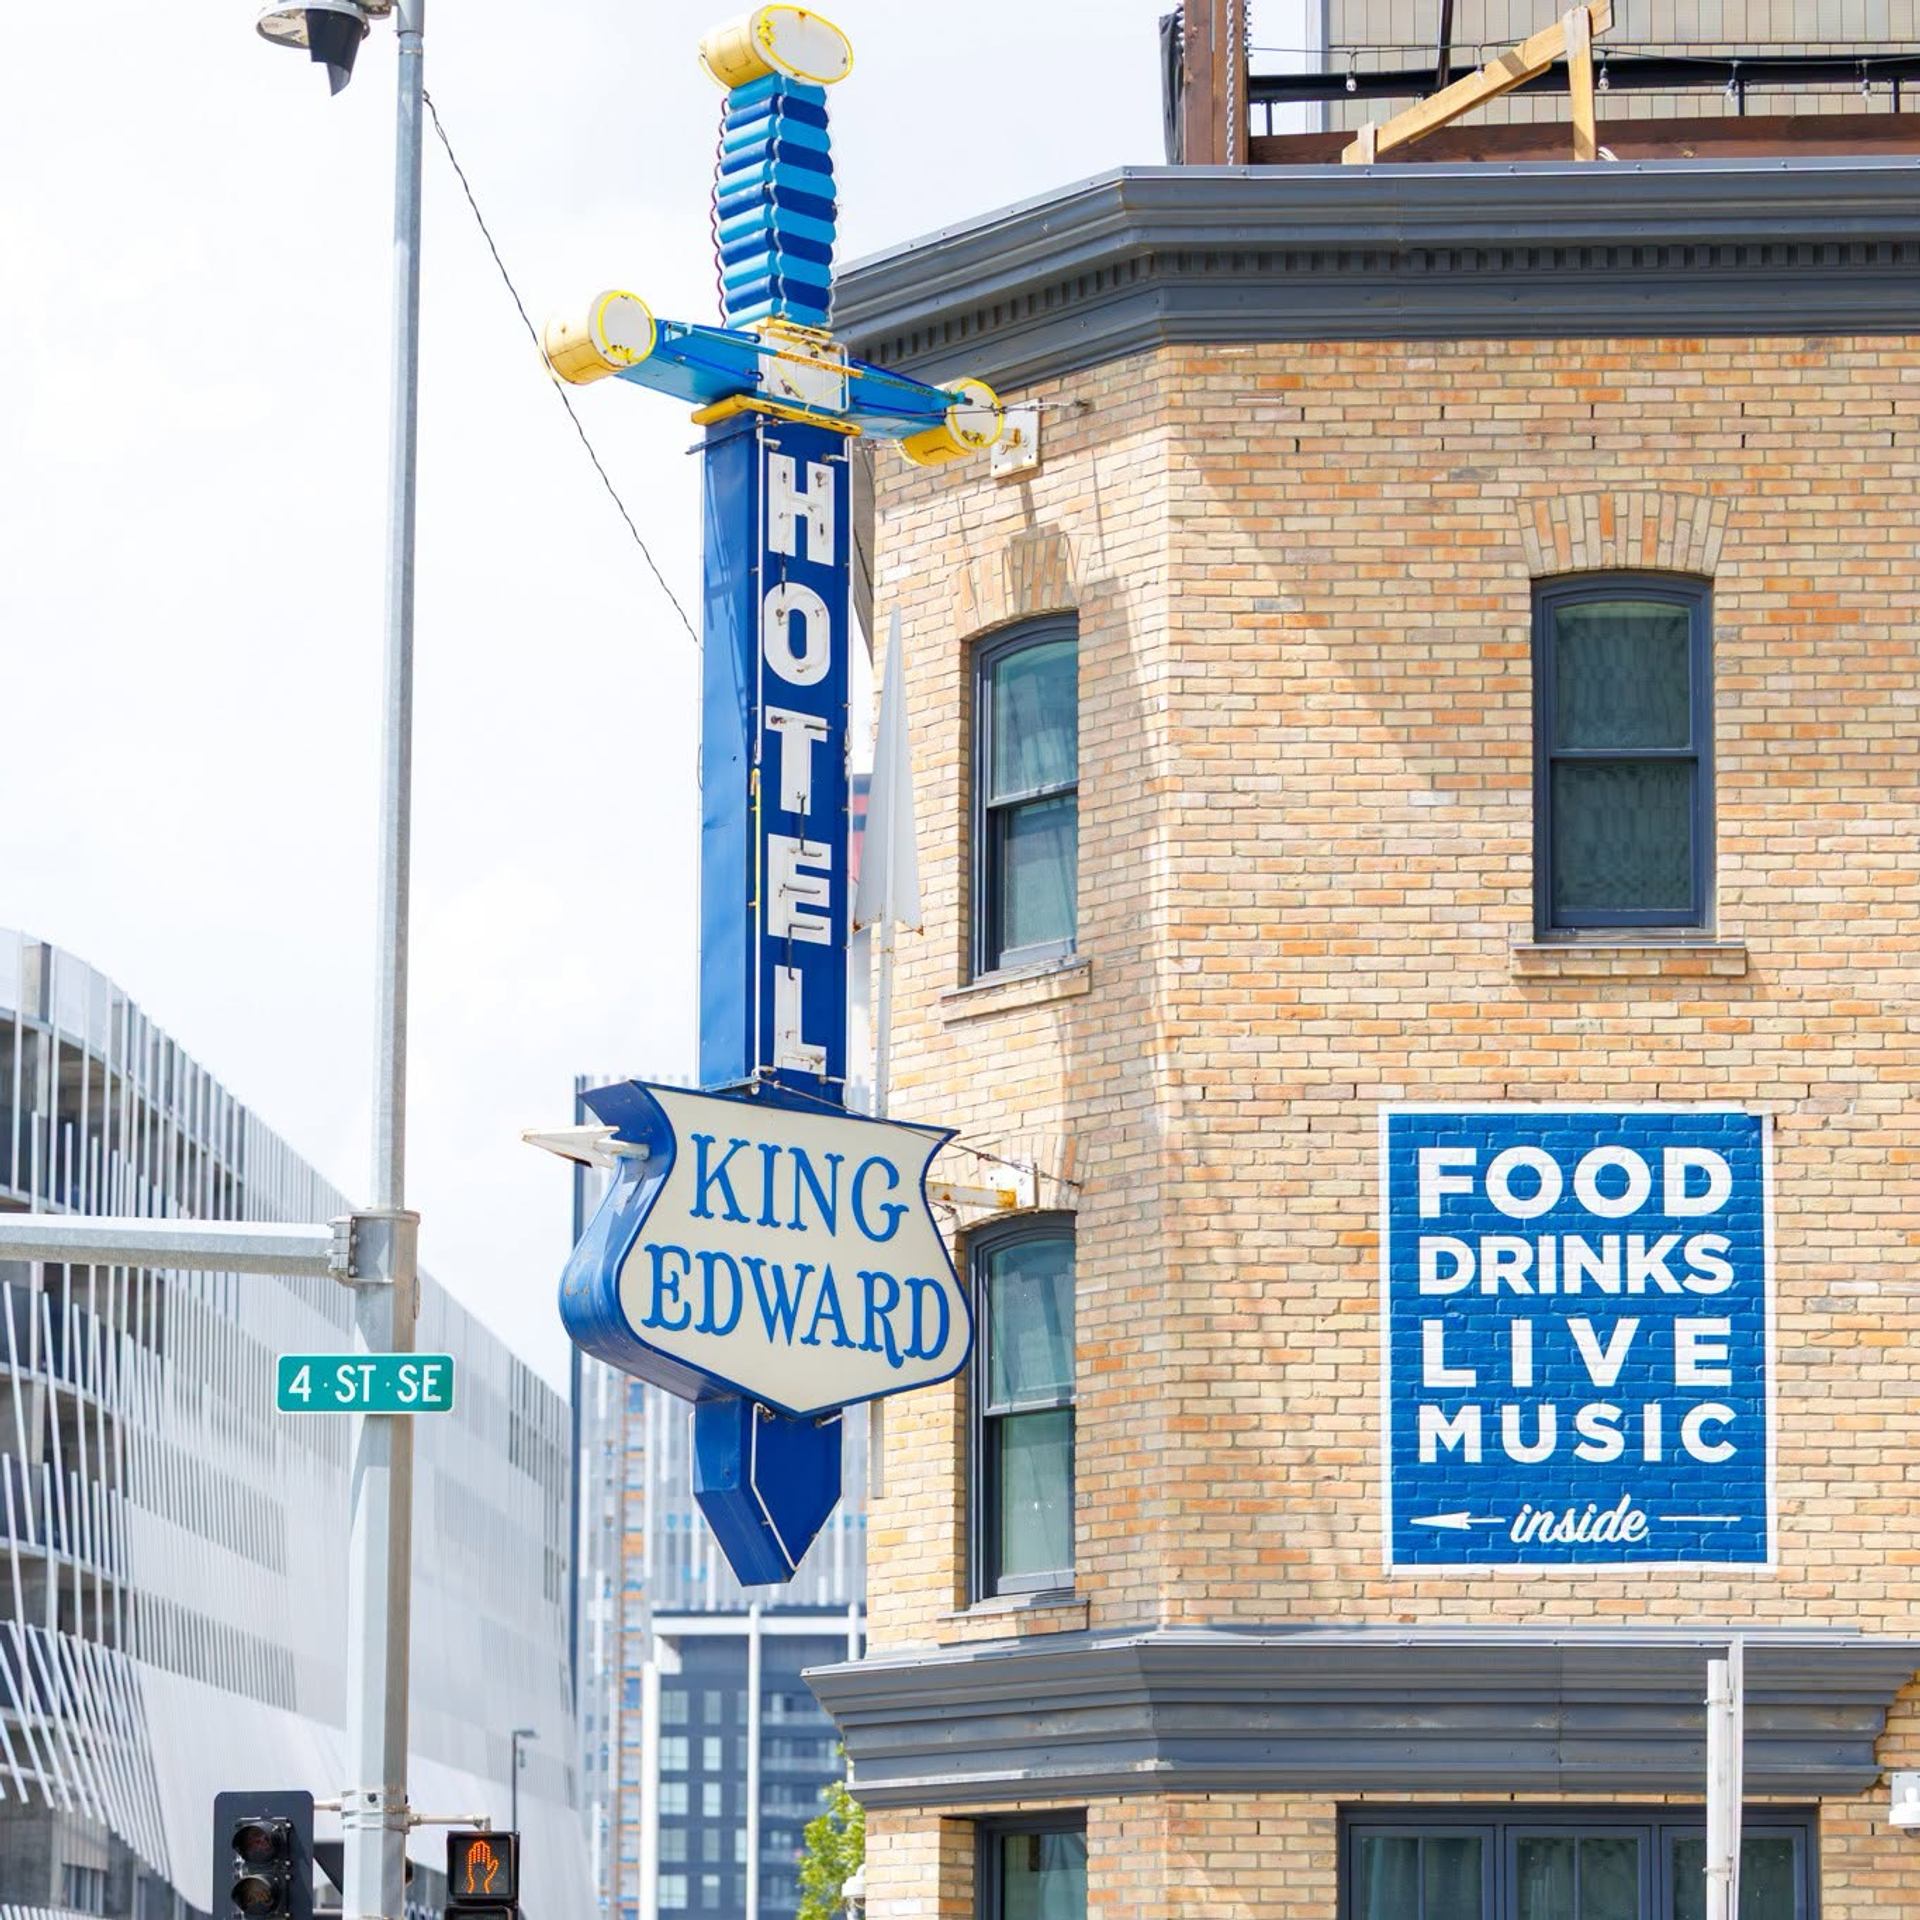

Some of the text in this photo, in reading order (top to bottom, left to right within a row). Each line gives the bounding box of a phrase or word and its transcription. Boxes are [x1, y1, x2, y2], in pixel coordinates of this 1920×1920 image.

[763, 452, 834, 1075] HOTEL
[689, 1133, 909, 1243] KING
[1418, 1146, 1733, 1219] FOOD
[1418, 1234, 1735, 1295] DRINKS
[642, 1244, 950, 1369] EDWARD
[288, 1364, 442, 1403] 4 ST SE
[1422, 1317, 1733, 1388] LIVE
[1418, 1403, 1738, 1464] MUSIC
[1510, 1494, 1650, 1544] inside
